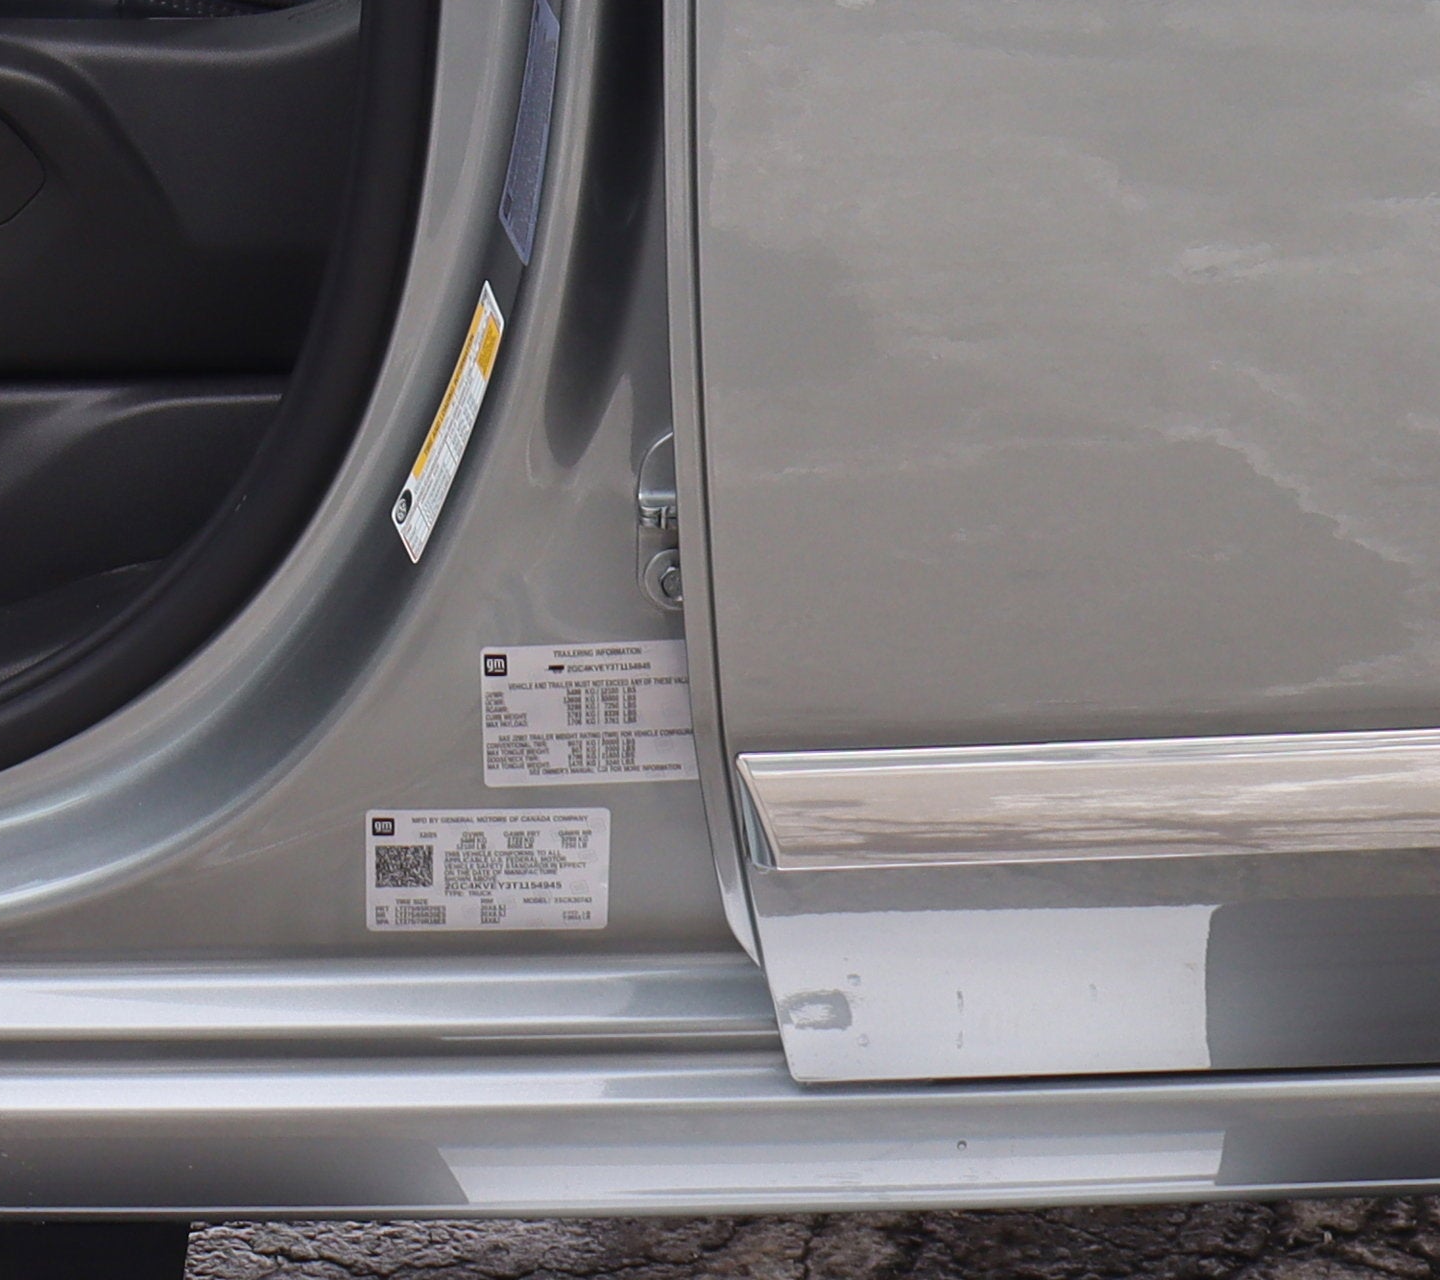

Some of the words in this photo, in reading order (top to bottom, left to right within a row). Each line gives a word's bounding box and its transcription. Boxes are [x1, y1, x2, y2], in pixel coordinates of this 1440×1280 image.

[486, 658, 505, 673] gm
[477, 815, 507, 823] MOTORS
[553, 814, 588, 822] COMPANY
[374, 821, 393, 833] gm
